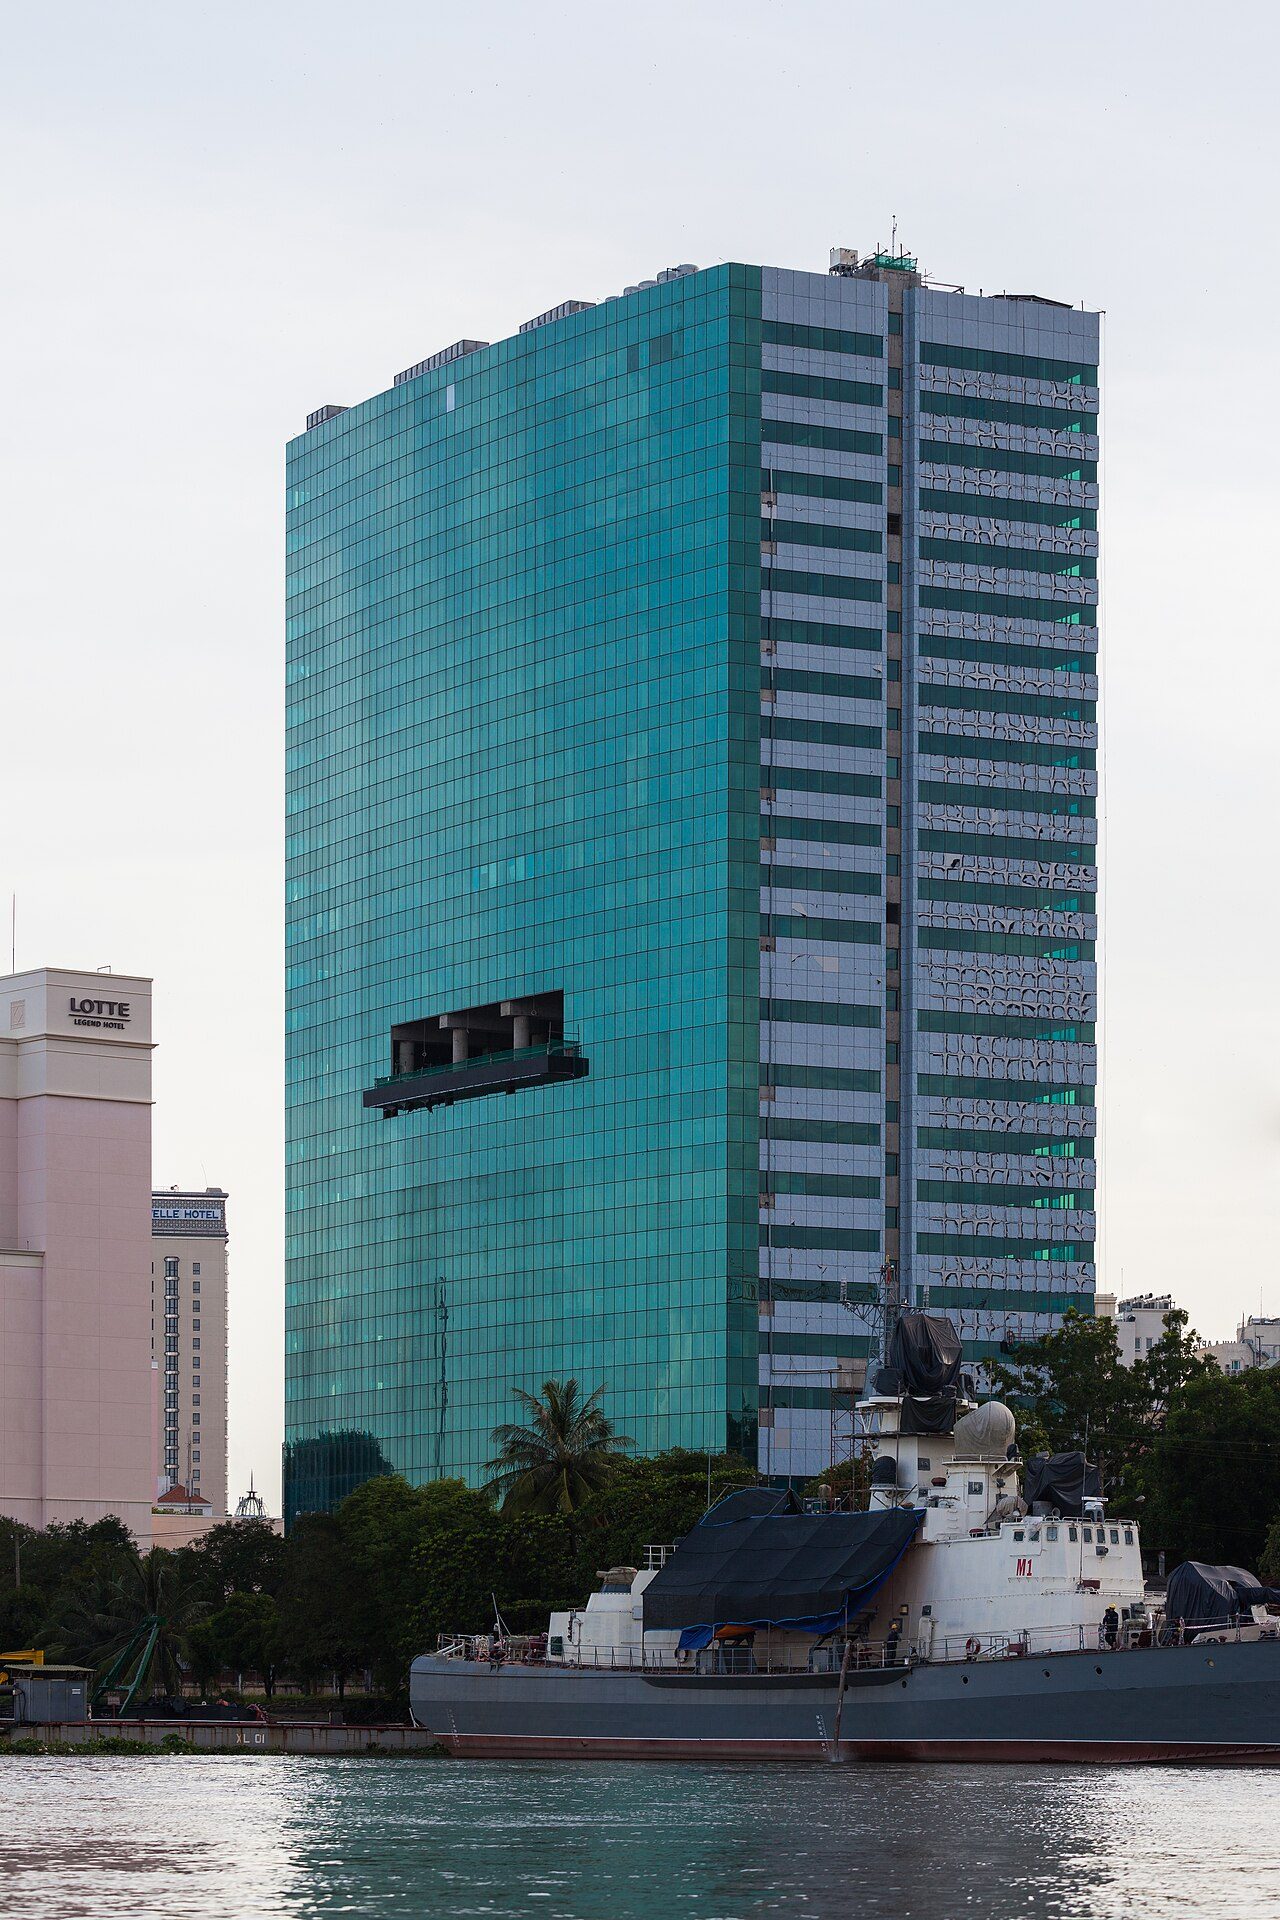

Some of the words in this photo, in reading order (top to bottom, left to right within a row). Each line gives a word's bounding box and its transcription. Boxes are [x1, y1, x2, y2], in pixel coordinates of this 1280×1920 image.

[70, 997, 130, 1017] LOTTE
[74, 1018, 101, 1028] LEGEND
[103, 1021, 125, 1030] HOTEL
[152, 1209, 179, 1219] ELLE
[184, 1210, 218, 1219] HOTEL
[1016, 1558, 1033, 1577] M1
[236, 1733, 250, 1744] XL
